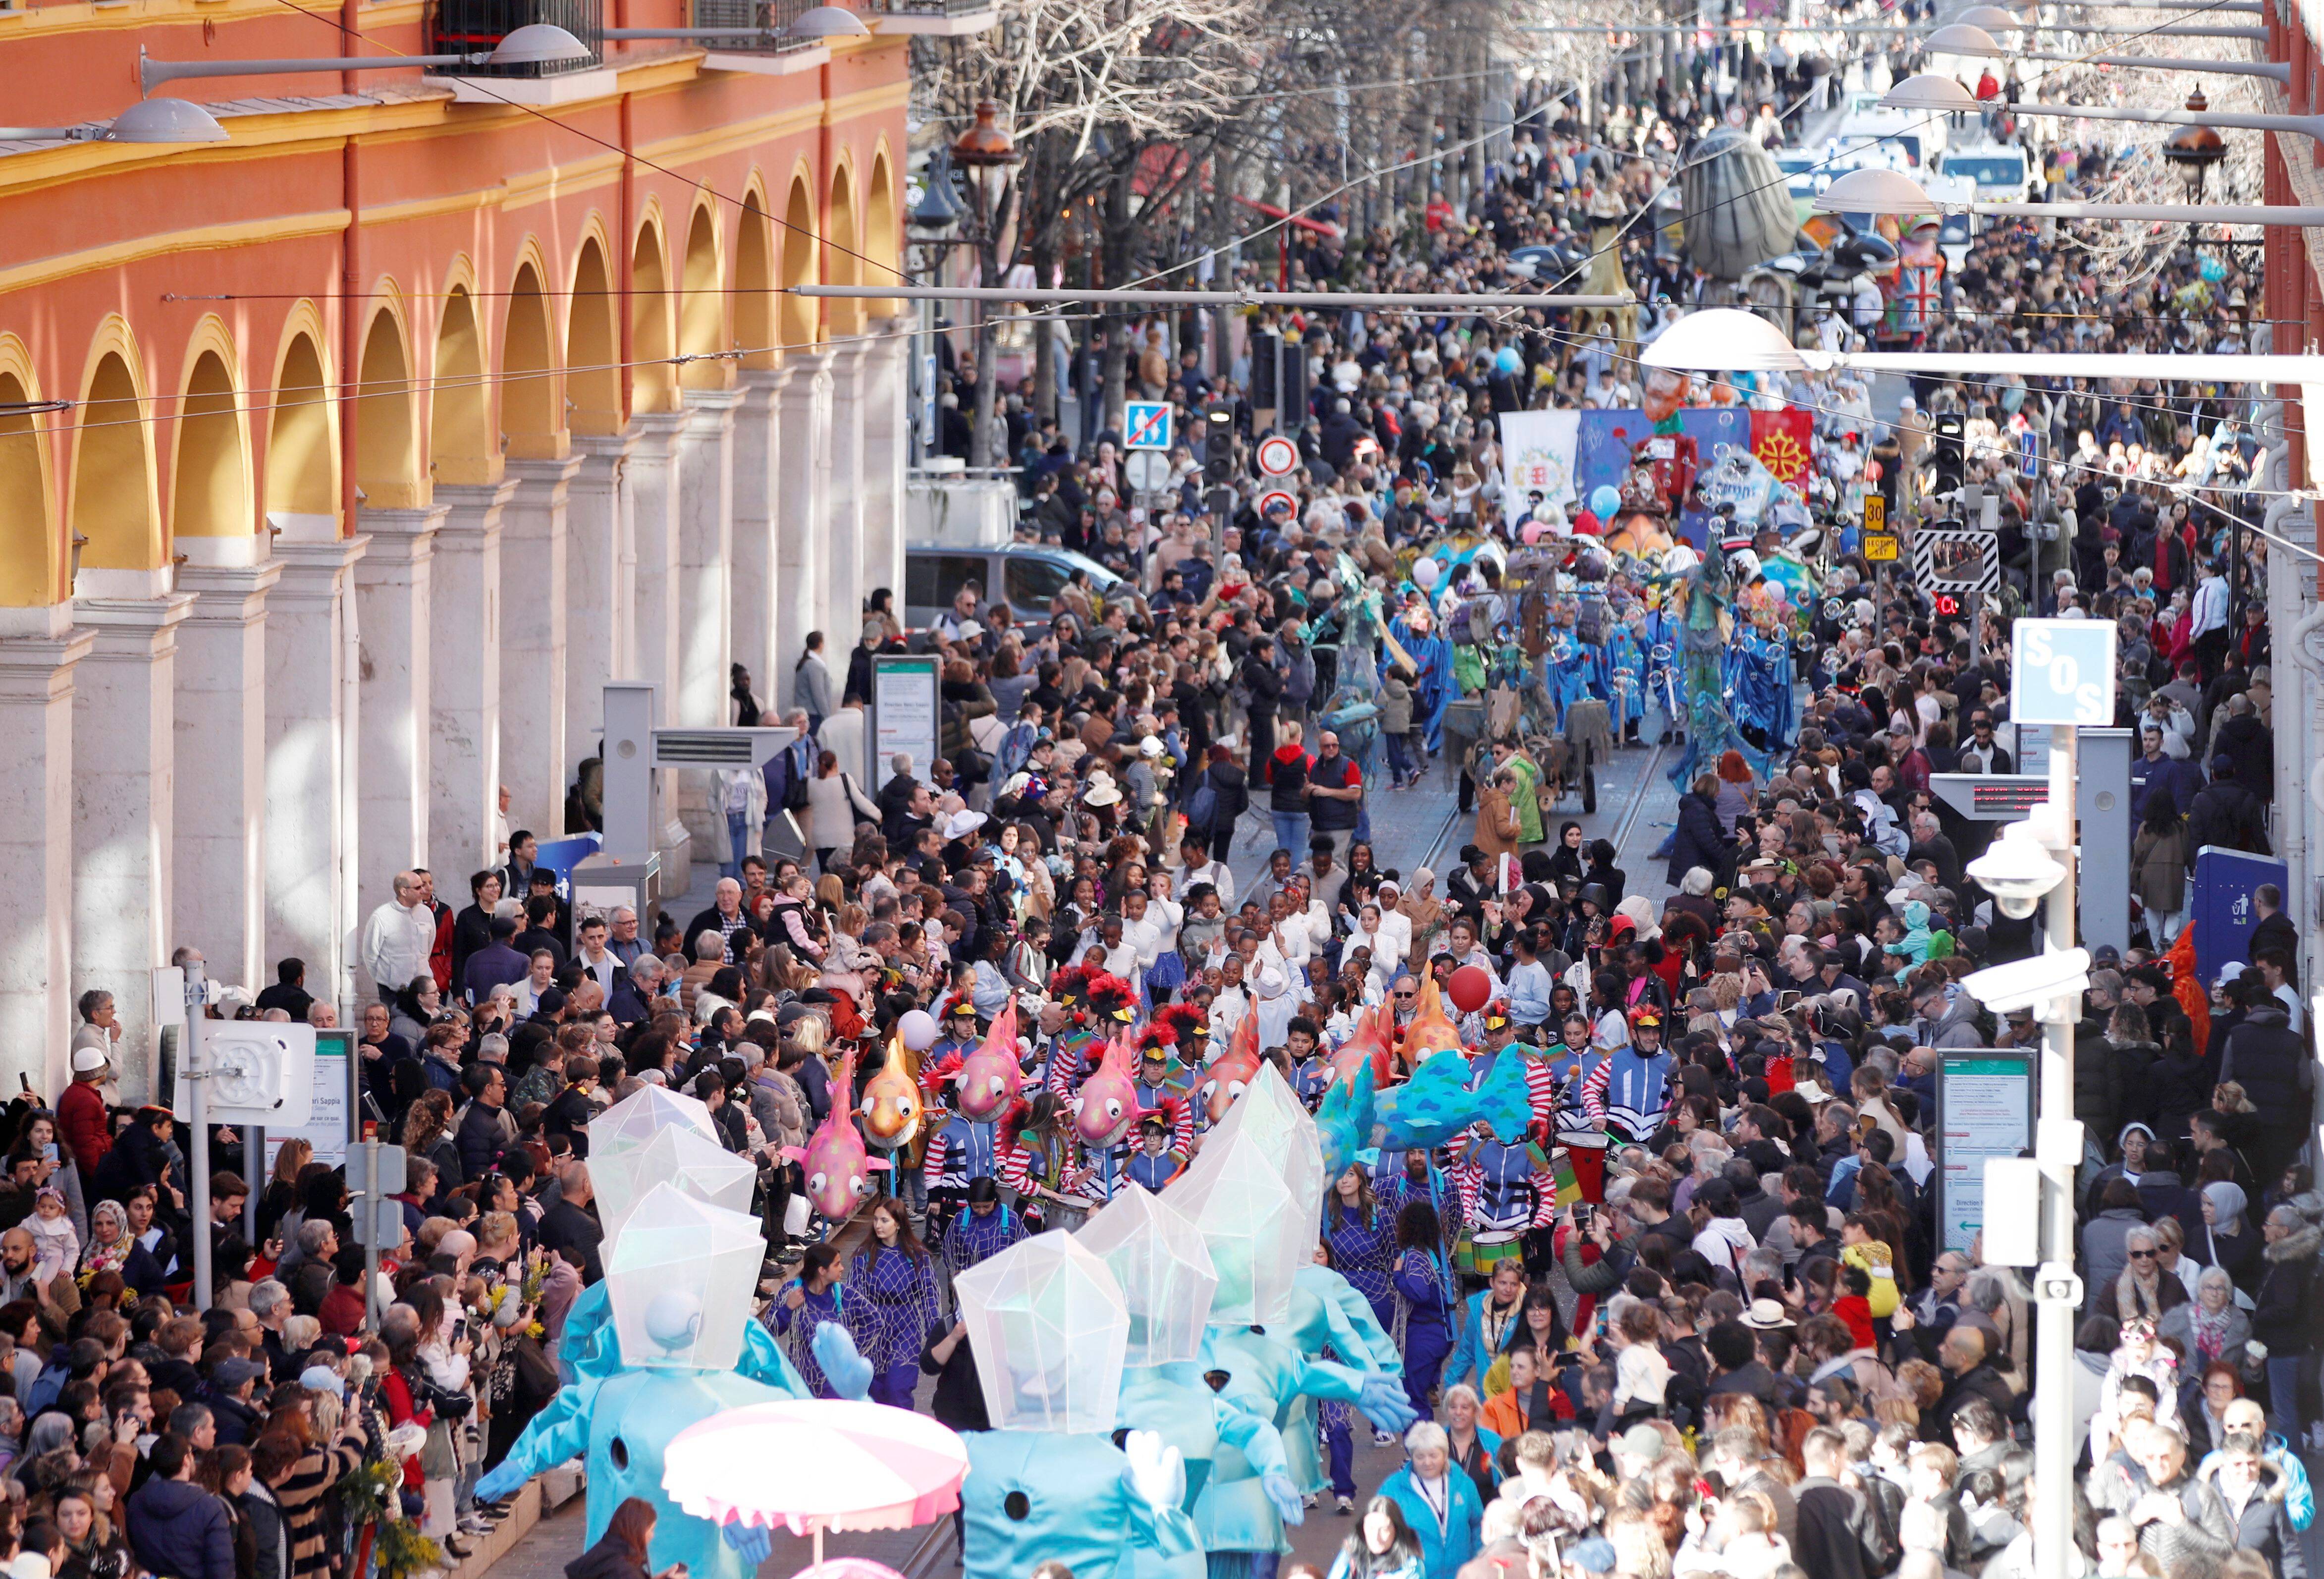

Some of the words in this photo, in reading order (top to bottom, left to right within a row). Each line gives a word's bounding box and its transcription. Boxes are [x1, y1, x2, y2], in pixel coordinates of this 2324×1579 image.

[1868, 504, 1882, 521] 30
[1866, 539, 1896, 547] SECTION
[2024, 627, 2104, 721] SOS
[320, 1097, 341, 1105] Sappia
